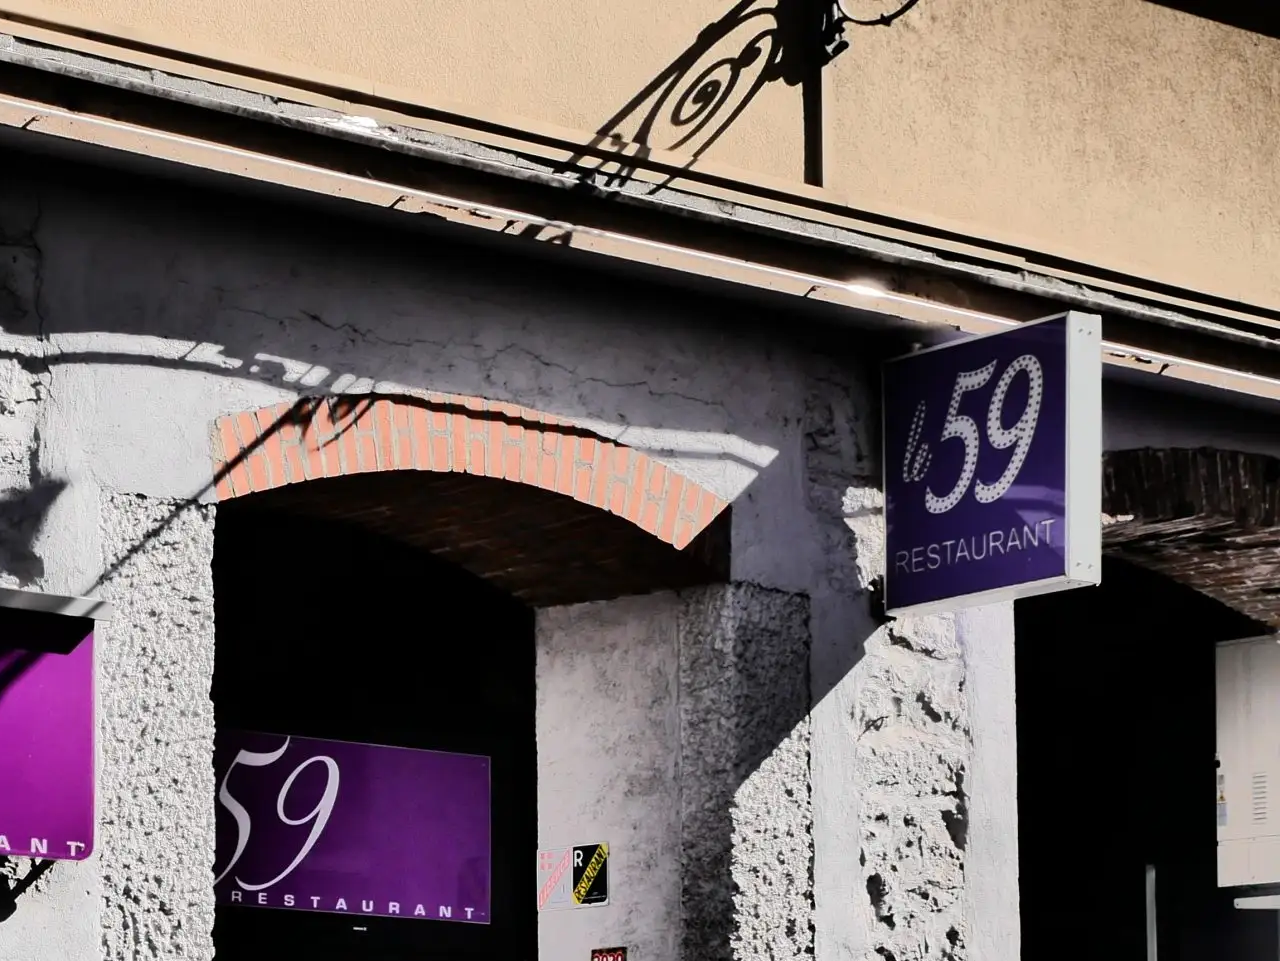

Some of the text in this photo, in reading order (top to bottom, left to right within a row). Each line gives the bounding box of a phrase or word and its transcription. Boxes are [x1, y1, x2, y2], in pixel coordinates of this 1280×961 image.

[924, 354, 1044, 514] 59
[895, 519, 1056, 573] RESTAURANT
[212, 735, 341, 892] 59
[230, 890, 475, 920] RESTAURANT
